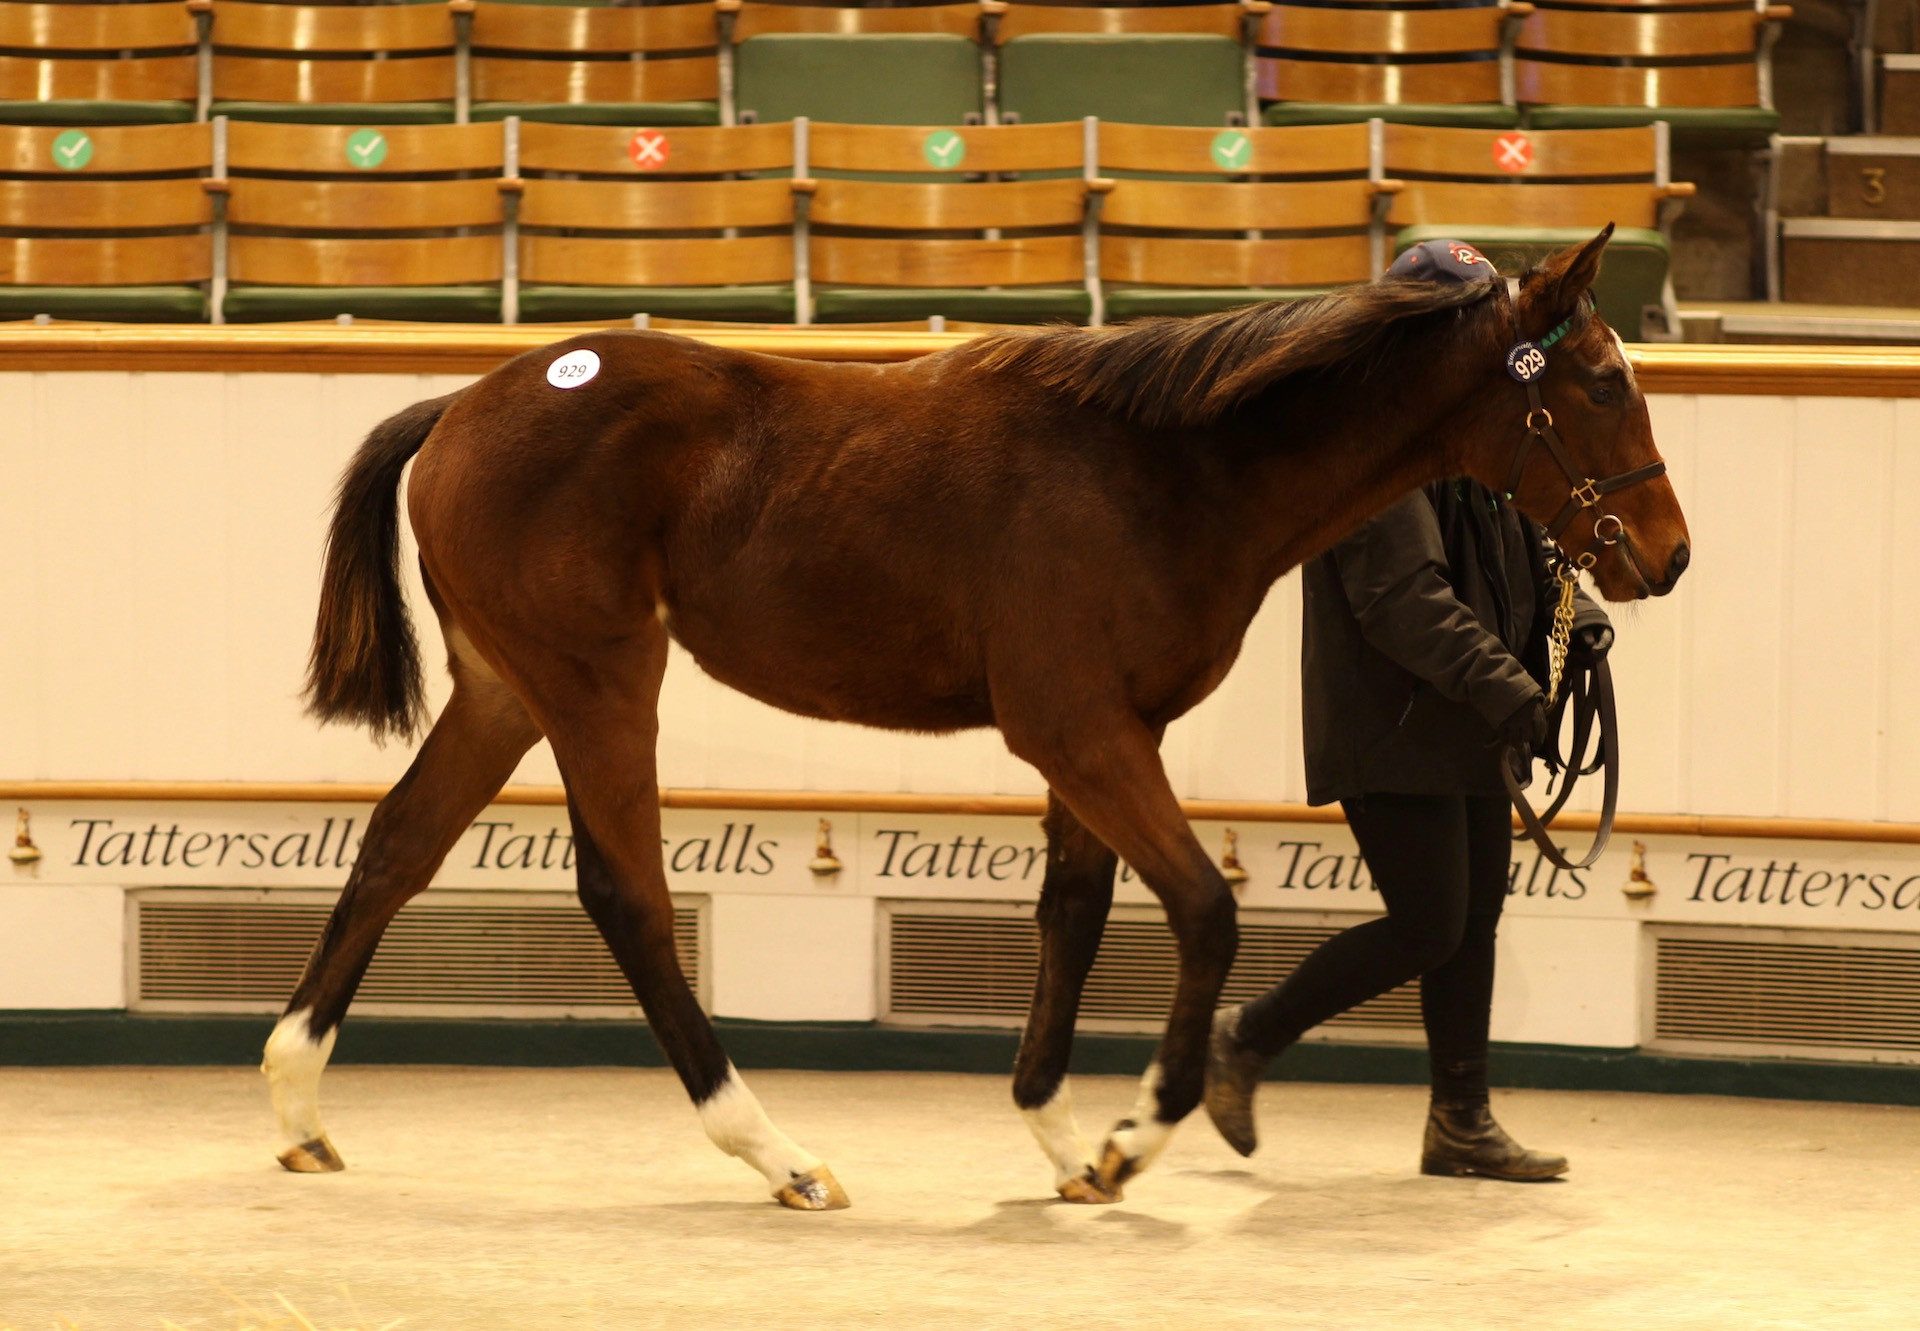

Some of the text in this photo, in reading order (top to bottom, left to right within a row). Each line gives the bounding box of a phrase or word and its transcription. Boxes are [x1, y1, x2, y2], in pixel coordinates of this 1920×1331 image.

[1861, 167, 1885, 204] 3
[558, 364, 587, 378] 929
[1515, 348, 1545, 379] 929
[471, 822, 779, 875] Tattalls
[875, 829, 1135, 883] Tatter
